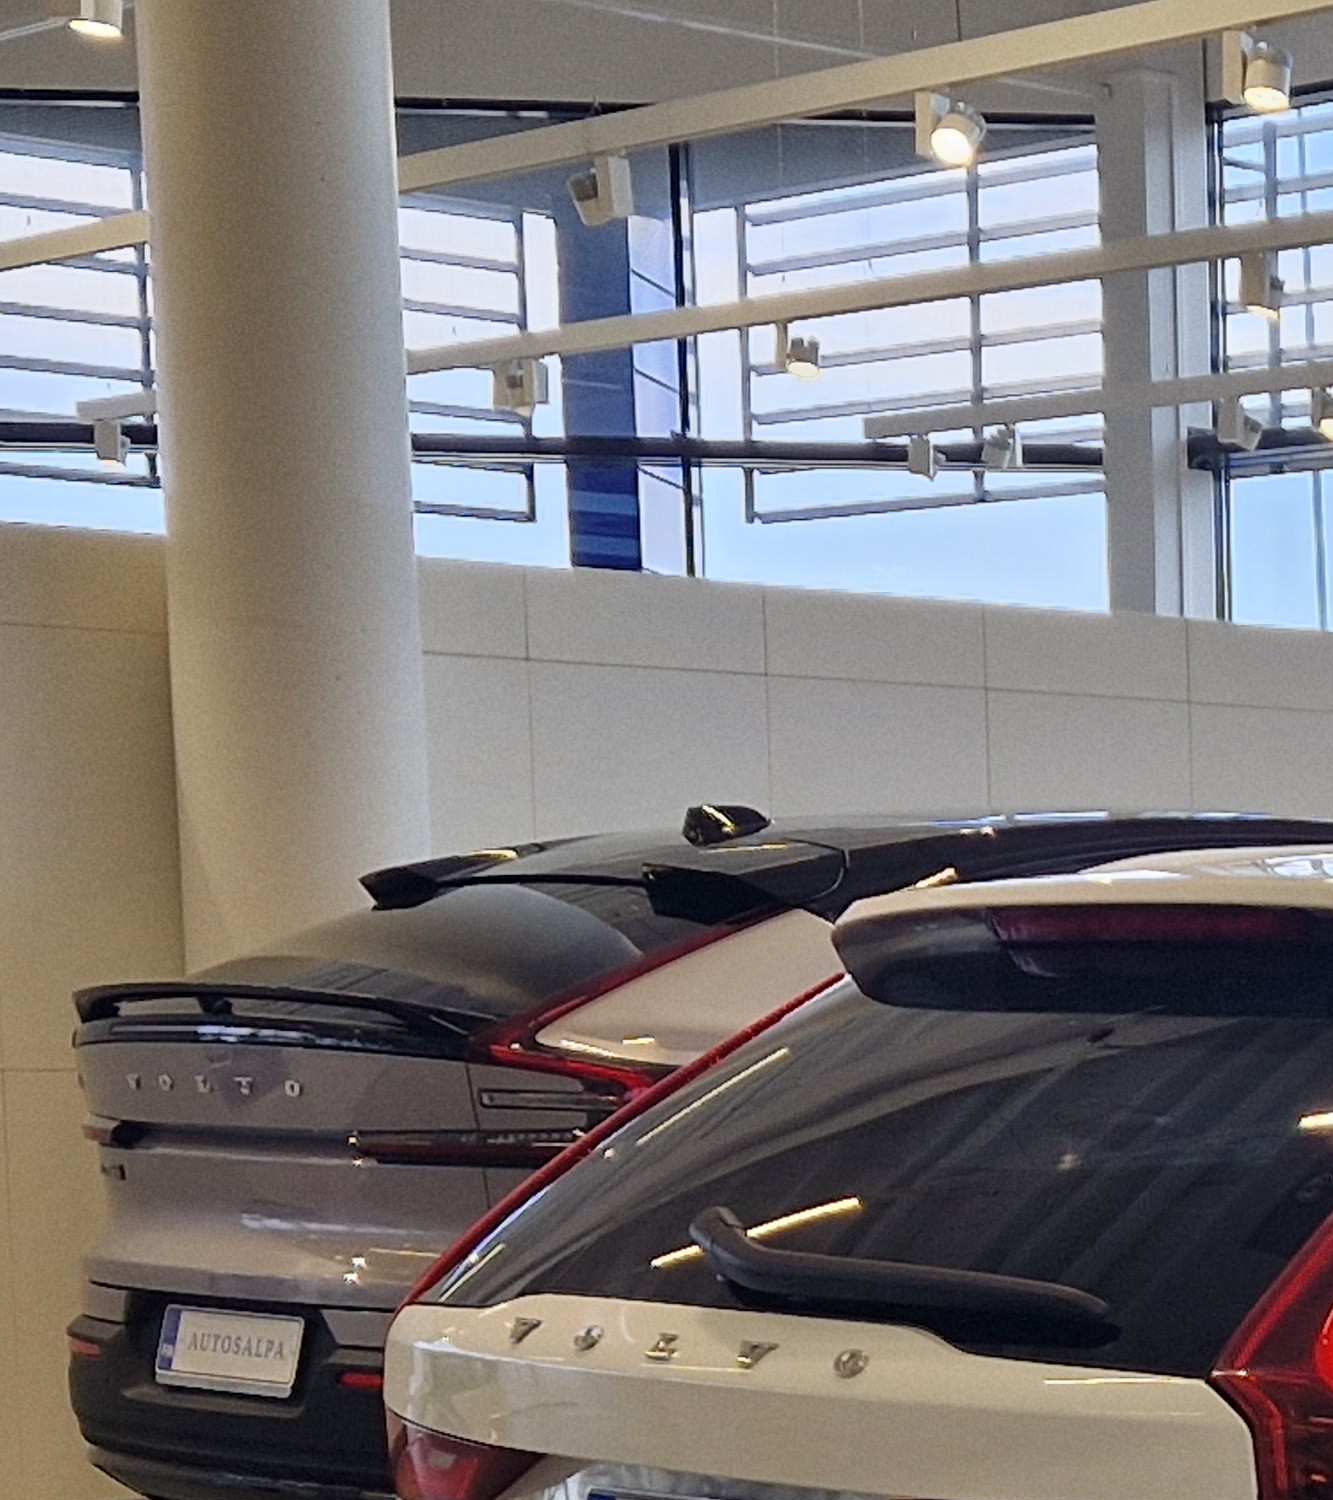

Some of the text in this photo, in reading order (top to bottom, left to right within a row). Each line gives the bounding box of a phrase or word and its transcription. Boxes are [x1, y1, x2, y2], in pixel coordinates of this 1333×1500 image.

[126, 1072, 301, 1098] VOLVO
[188, 1332, 285, 1360] AUTOSALPA
[508, 1316, 869, 1379] VOLVO
